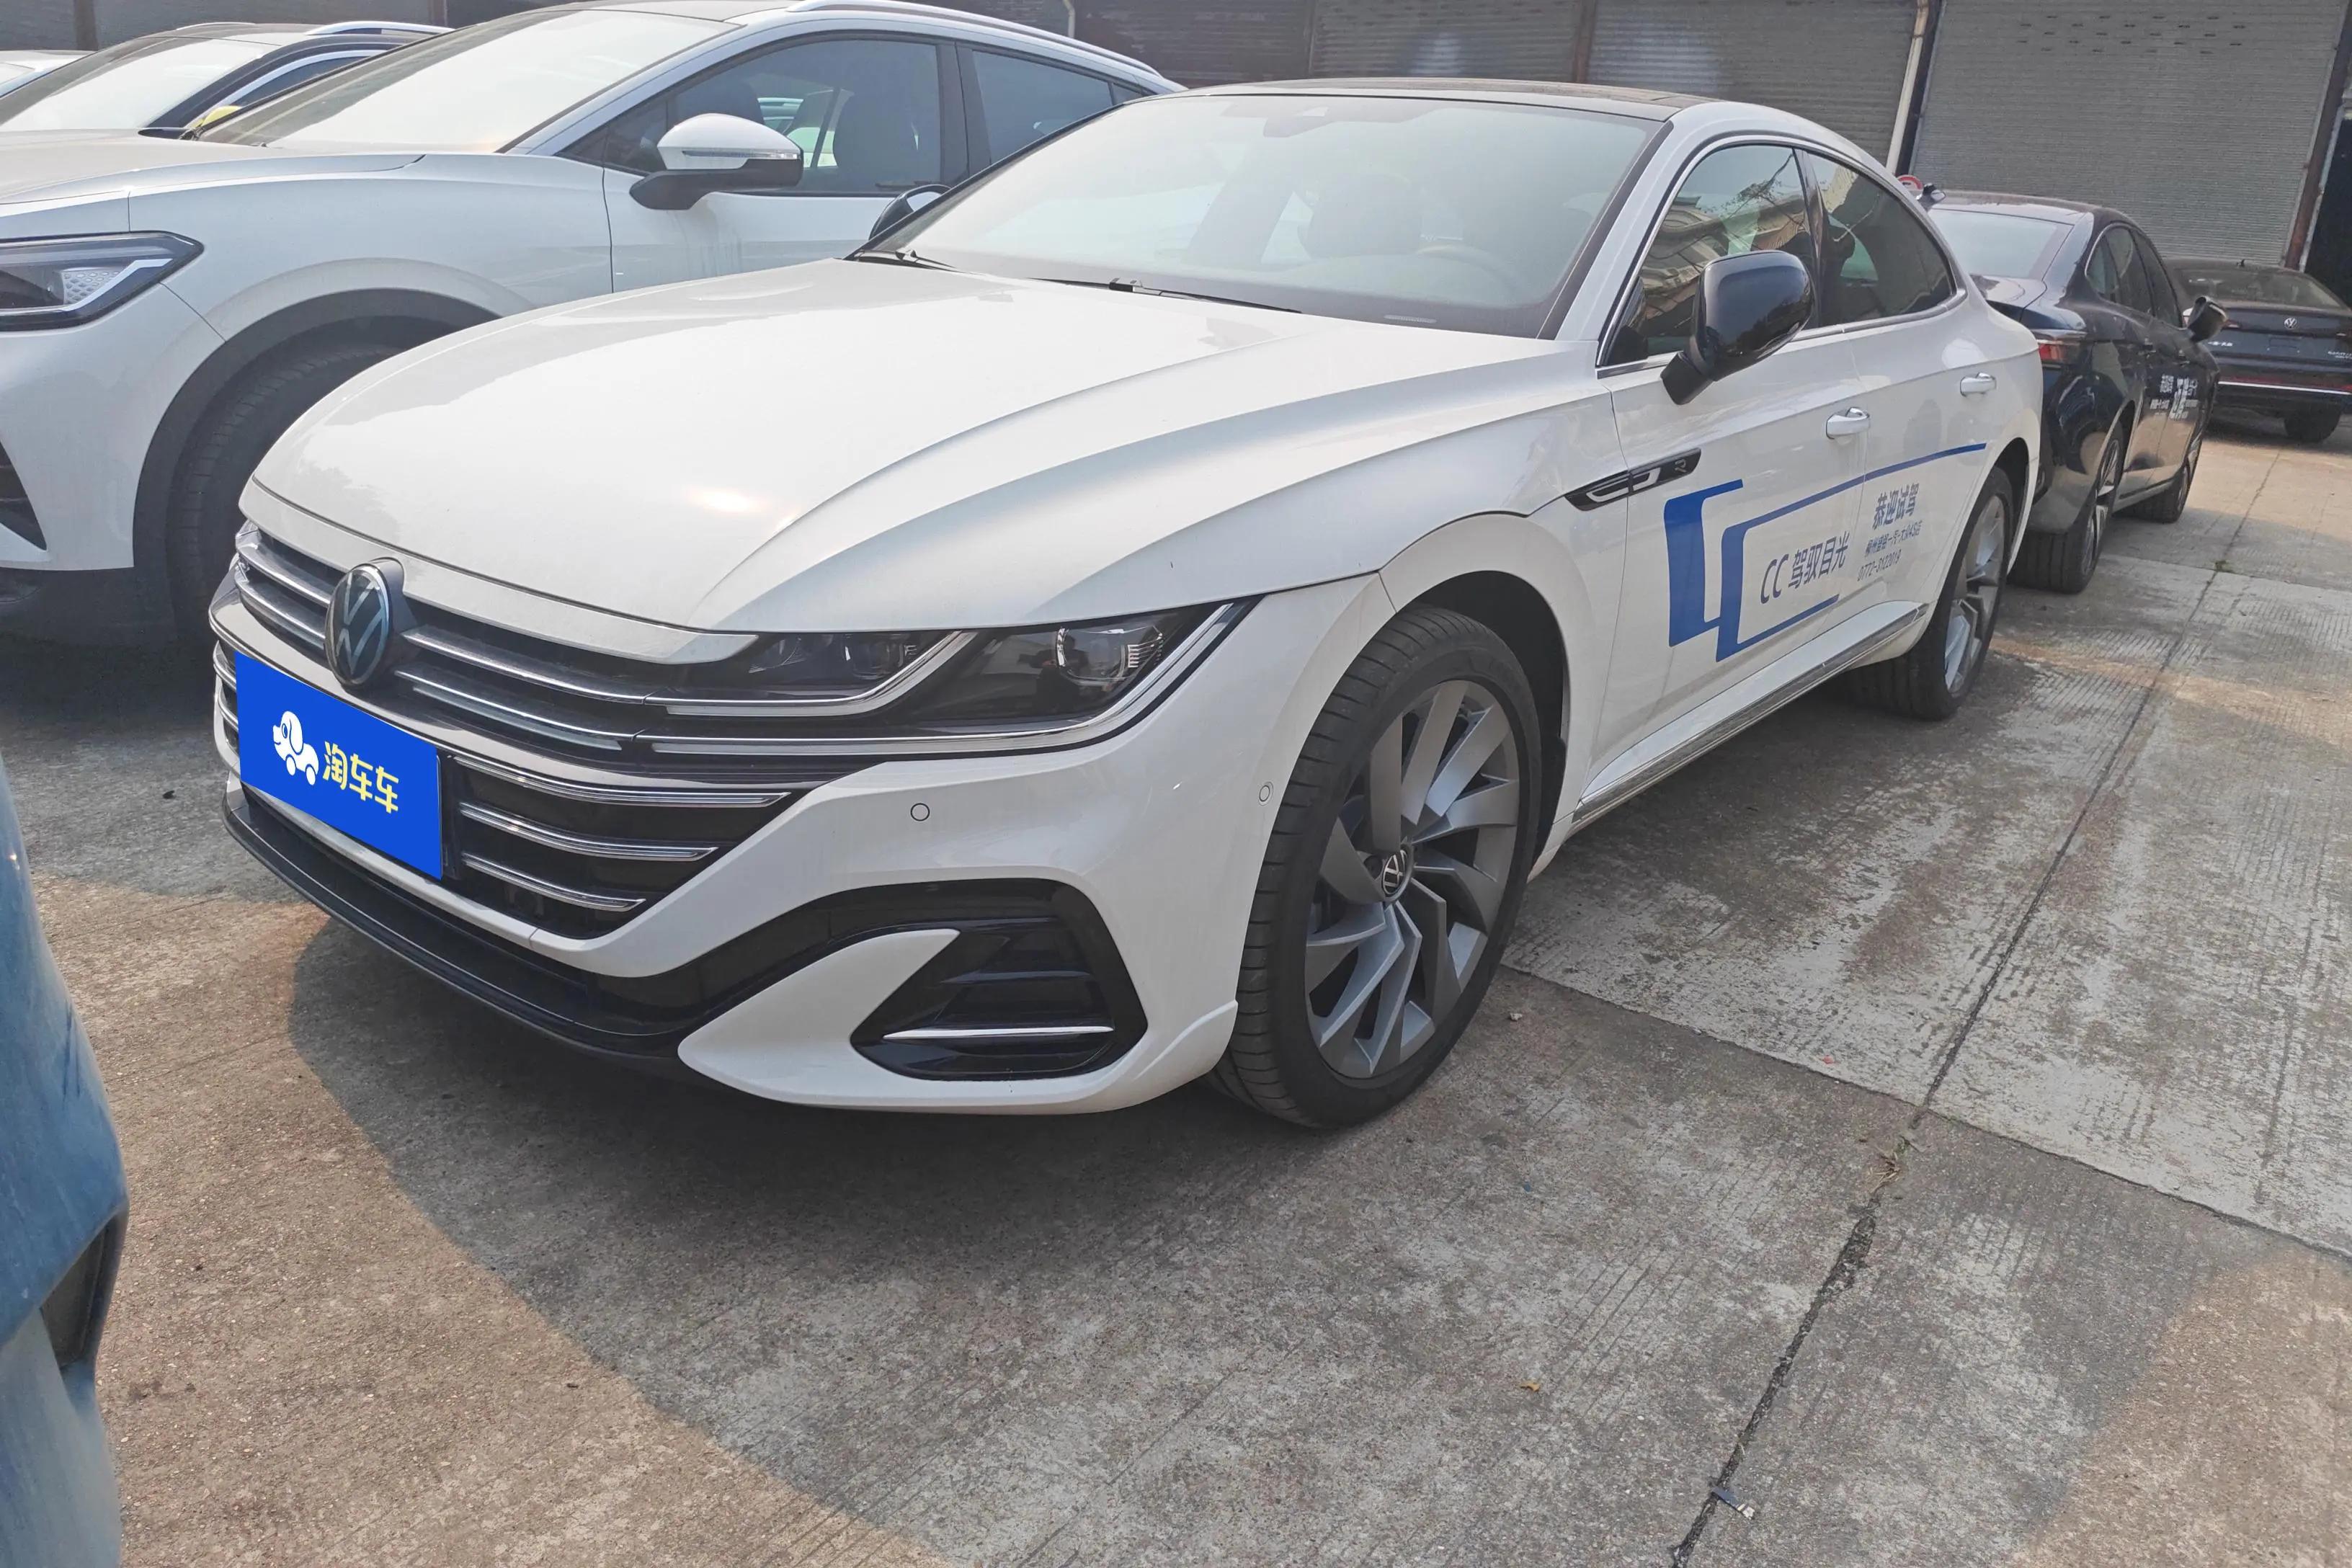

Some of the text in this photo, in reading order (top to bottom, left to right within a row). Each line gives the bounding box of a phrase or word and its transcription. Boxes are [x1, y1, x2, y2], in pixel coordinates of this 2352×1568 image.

[1872, 483, 1920, 530] 恭迎试驾
[1760, 530, 1850, 604] CC 驾驭目光
